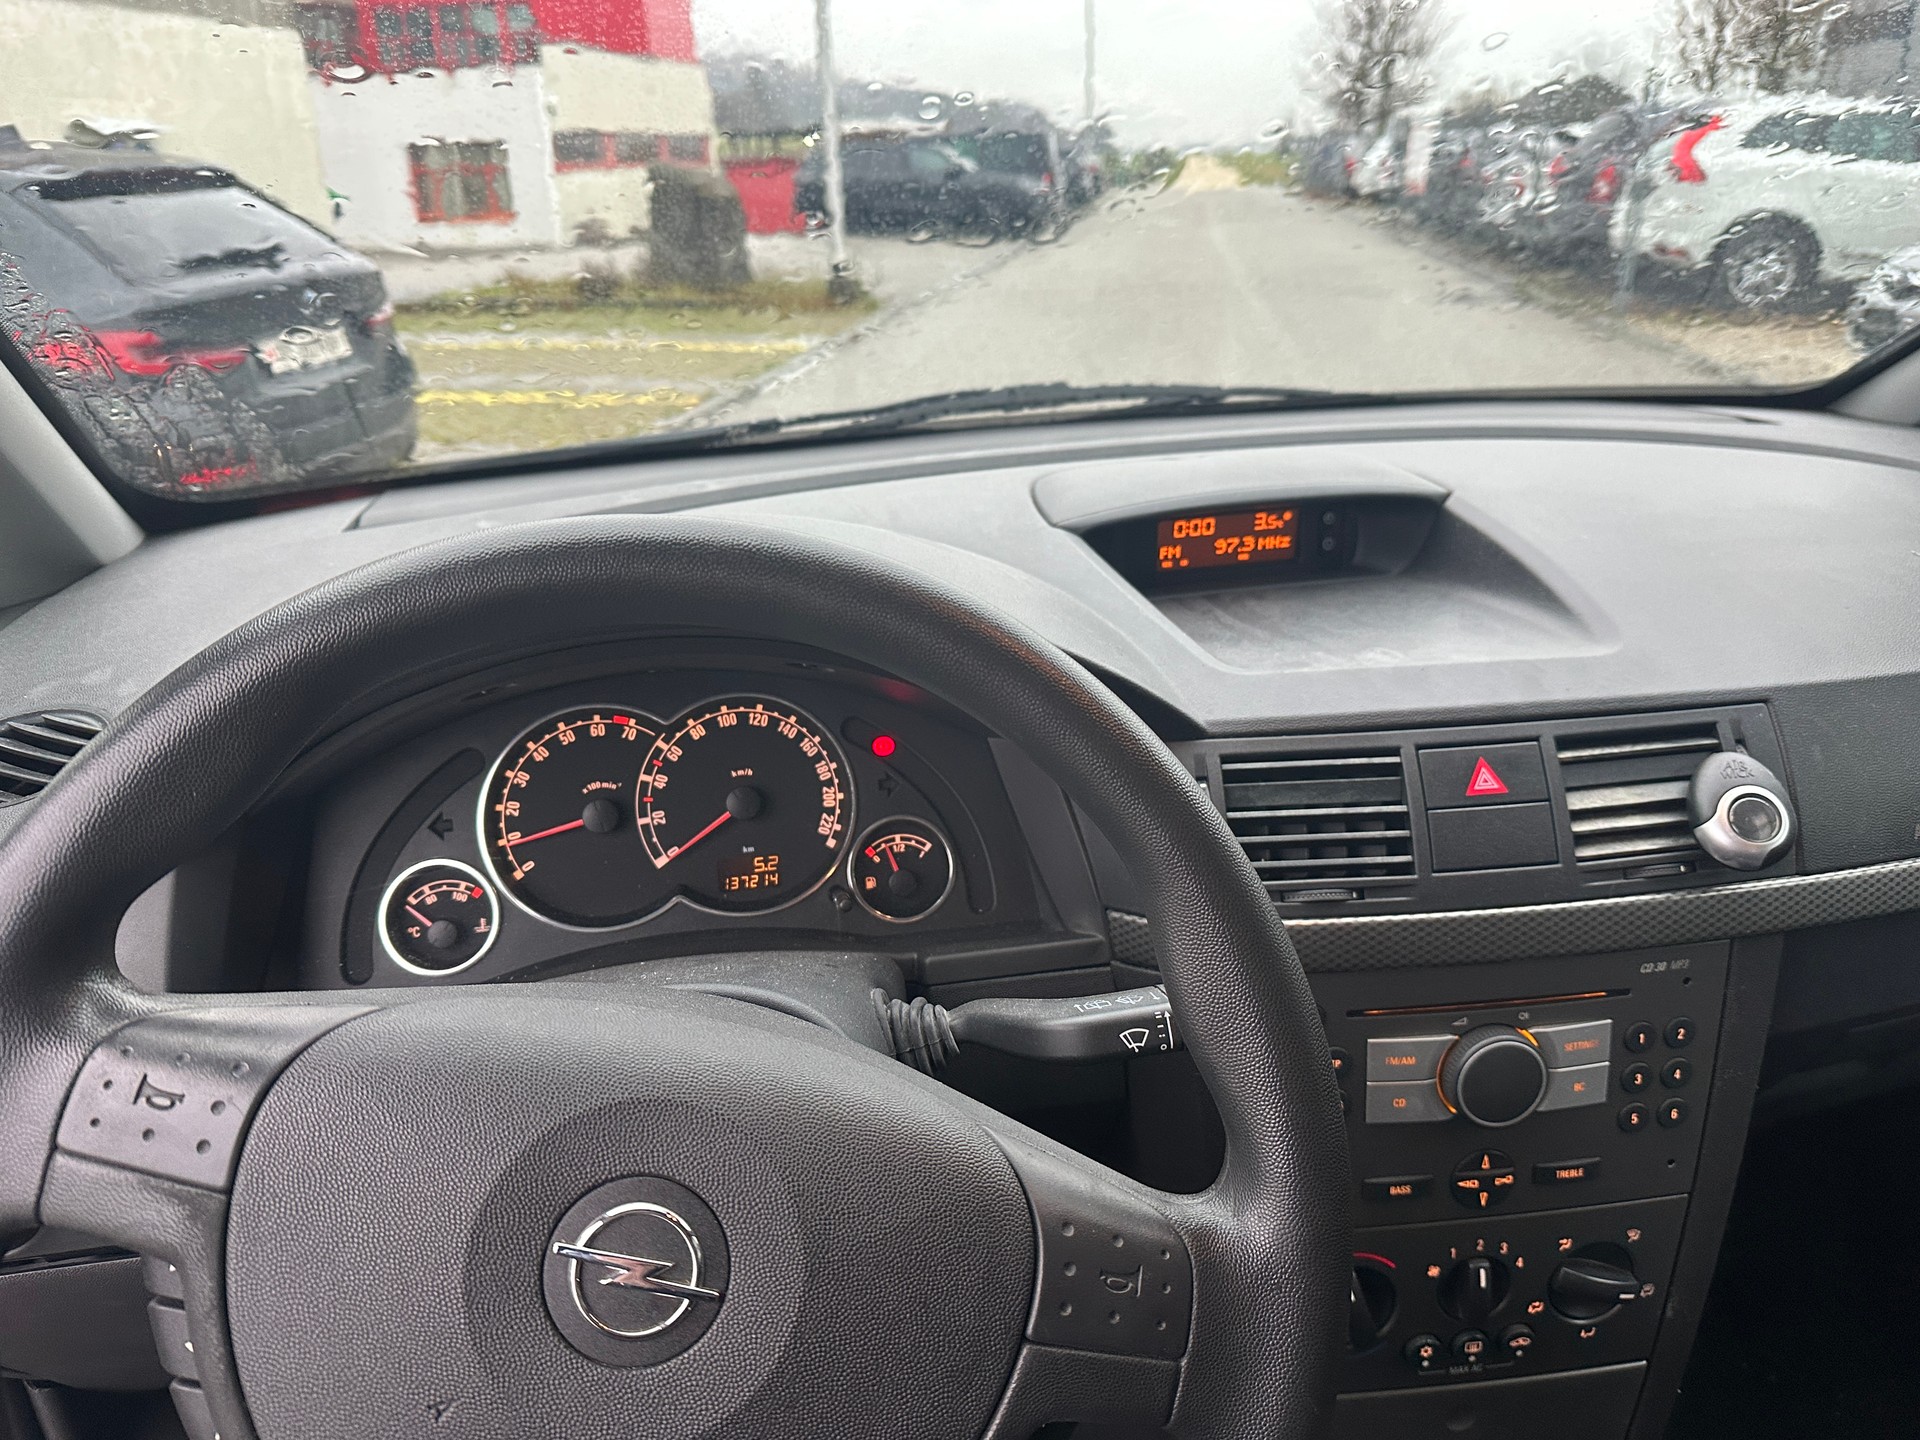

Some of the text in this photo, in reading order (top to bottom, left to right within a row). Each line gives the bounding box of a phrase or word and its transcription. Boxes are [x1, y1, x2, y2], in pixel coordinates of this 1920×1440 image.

[1173, 517, 1216, 538] 0:00
[1214, 535, 1255, 555] 97.3
[1159, 545, 1181, 560] FM
[717, 713, 737, 728] 100
[749, 713, 769, 727] 120
[558, 729, 576, 745] 50
[590, 724, 606, 737] 60
[621, 726, 637, 741] 70
[689, 724, 706, 741] 80
[778, 721, 798, 739] 140
[532, 746, 550, 762] 40
[666, 745, 683, 762] 60
[799, 737, 818, 757] 160
[731, 768, 753, 778] km/h
[814, 760, 832, 781] 180
[514, 771, 530, 788] 30
[653, 774, 668, 789] 40
[822, 786, 836, 807] 200
[506, 801, 520, 817] 20
[652, 810, 666, 825] 20
[817, 813, 834, 835] 220
[893, 844, 905, 852] 1/2
[522, 861, 535, 872] 0
[754, 855, 779, 872] 5.2
[726, 873, 779, 890] 137214
[425, 894, 437, 905] 80
[452, 892, 468, 902] 100
[1639, 1033, 1646, 1044] 1
[1677, 1028, 1686, 1040] 2
[1385, 1055, 1417, 1066] FM/AM
[1634, 1073, 1643, 1085] 3
[1673, 1068, 1681, 1080] 4
[1393, 1098, 1407, 1108] CD
[1630, 1113, 1640, 1125] 5
[1670, 1108, 1679, 1120] 6
[1556, 1167, 1584, 1179] TREBLE
[1390, 1184, 1412, 1196] BASS
[1476, 1238, 1484, 1251] 2
[1500, 1241, 1509, 1255] 3
[1516, 1256, 1524, 1269] 4
